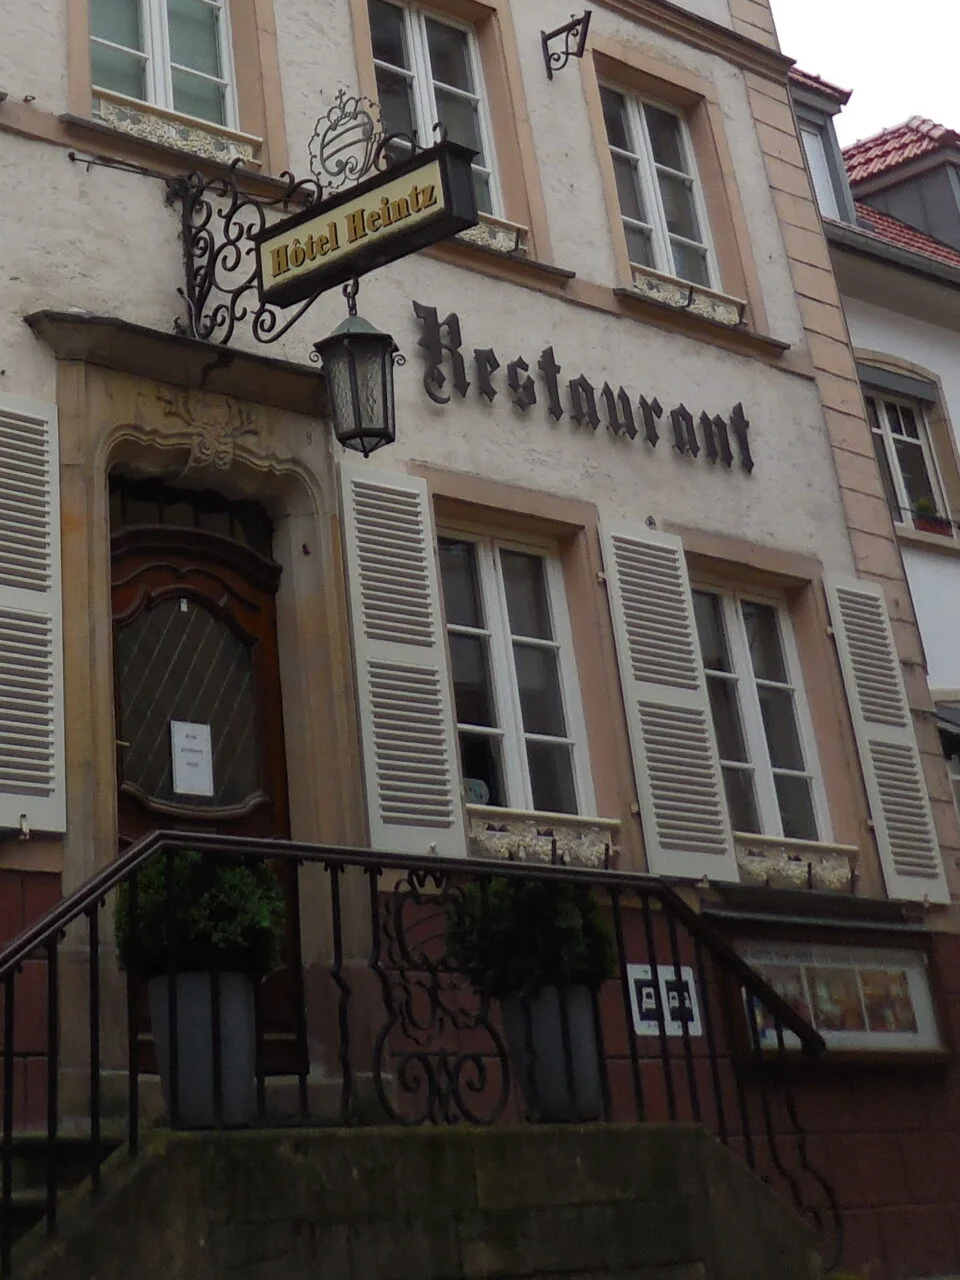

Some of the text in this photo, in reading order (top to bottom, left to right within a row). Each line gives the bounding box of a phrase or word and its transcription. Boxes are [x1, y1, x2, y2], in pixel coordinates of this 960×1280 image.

[270, 184, 438, 278] Hôtel Heintz
[412, 300, 754, 474] Restaurant
